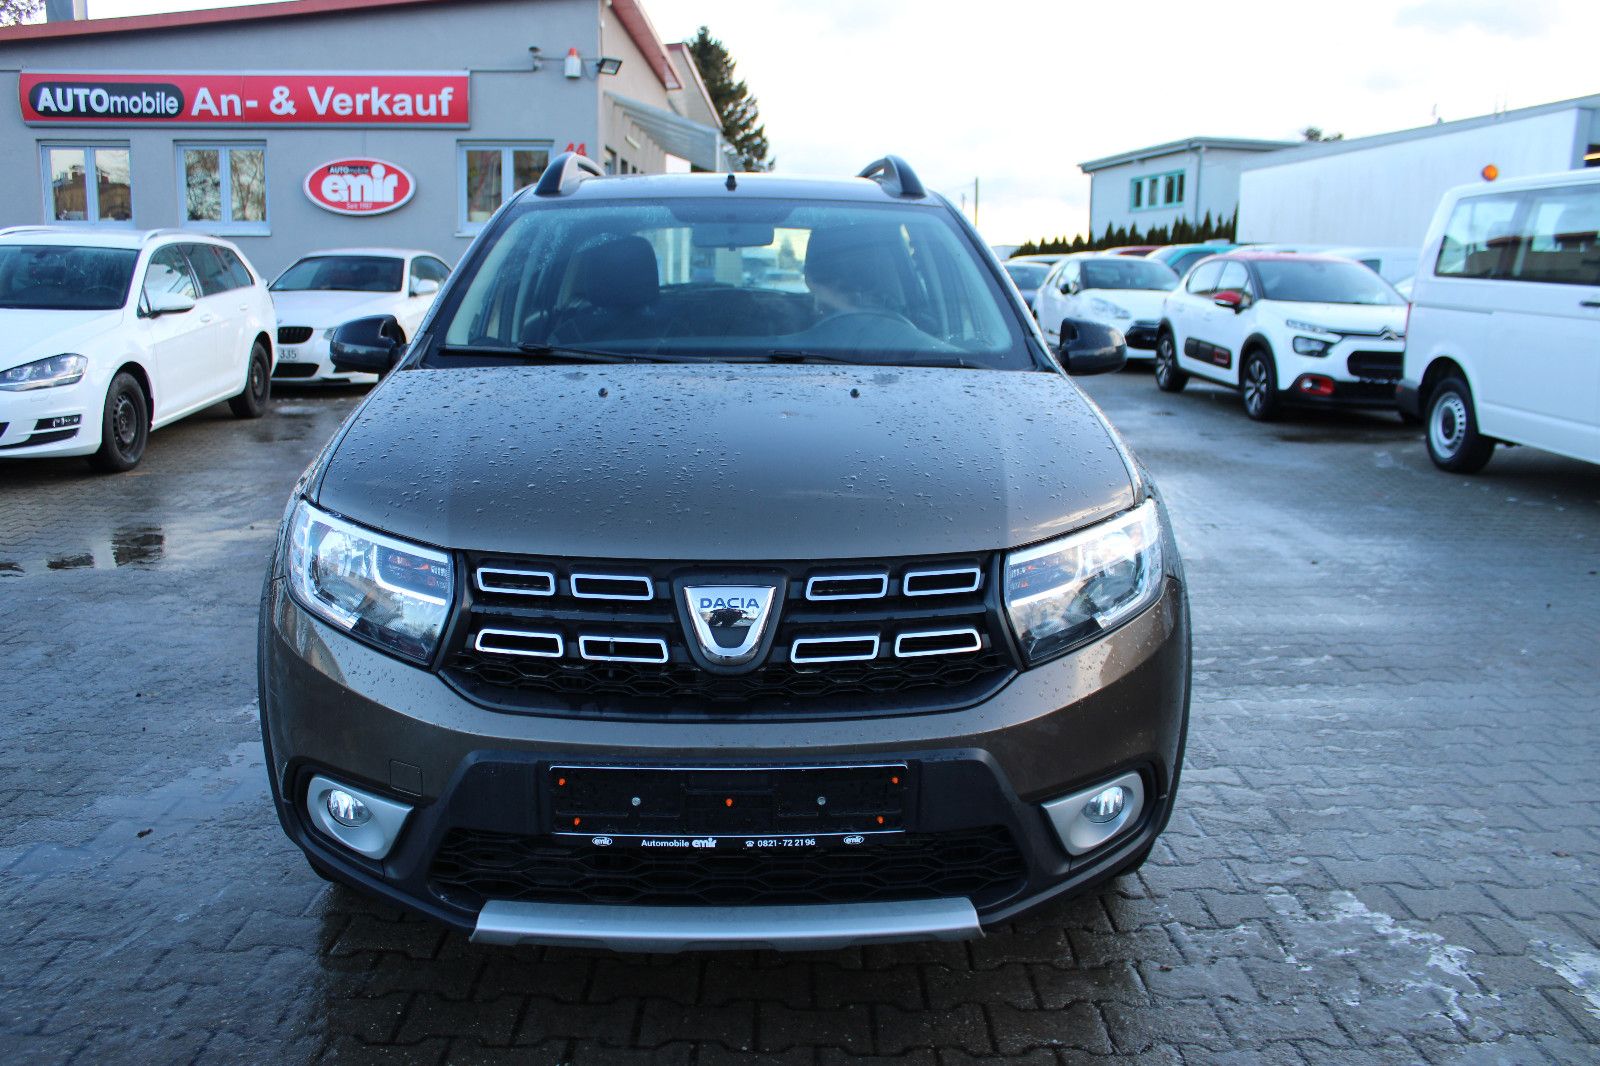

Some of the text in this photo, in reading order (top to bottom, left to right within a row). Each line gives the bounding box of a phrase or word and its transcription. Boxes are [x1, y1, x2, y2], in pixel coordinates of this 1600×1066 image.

[37, 87, 179, 114] AUTOmobile
[269, 86, 297, 115] &
[307, 86, 454, 116] Verkauf
[321, 163, 398, 202] emir
[700, 597, 760, 609] DACIA
[641, 838, 717, 848] Automobile emir
